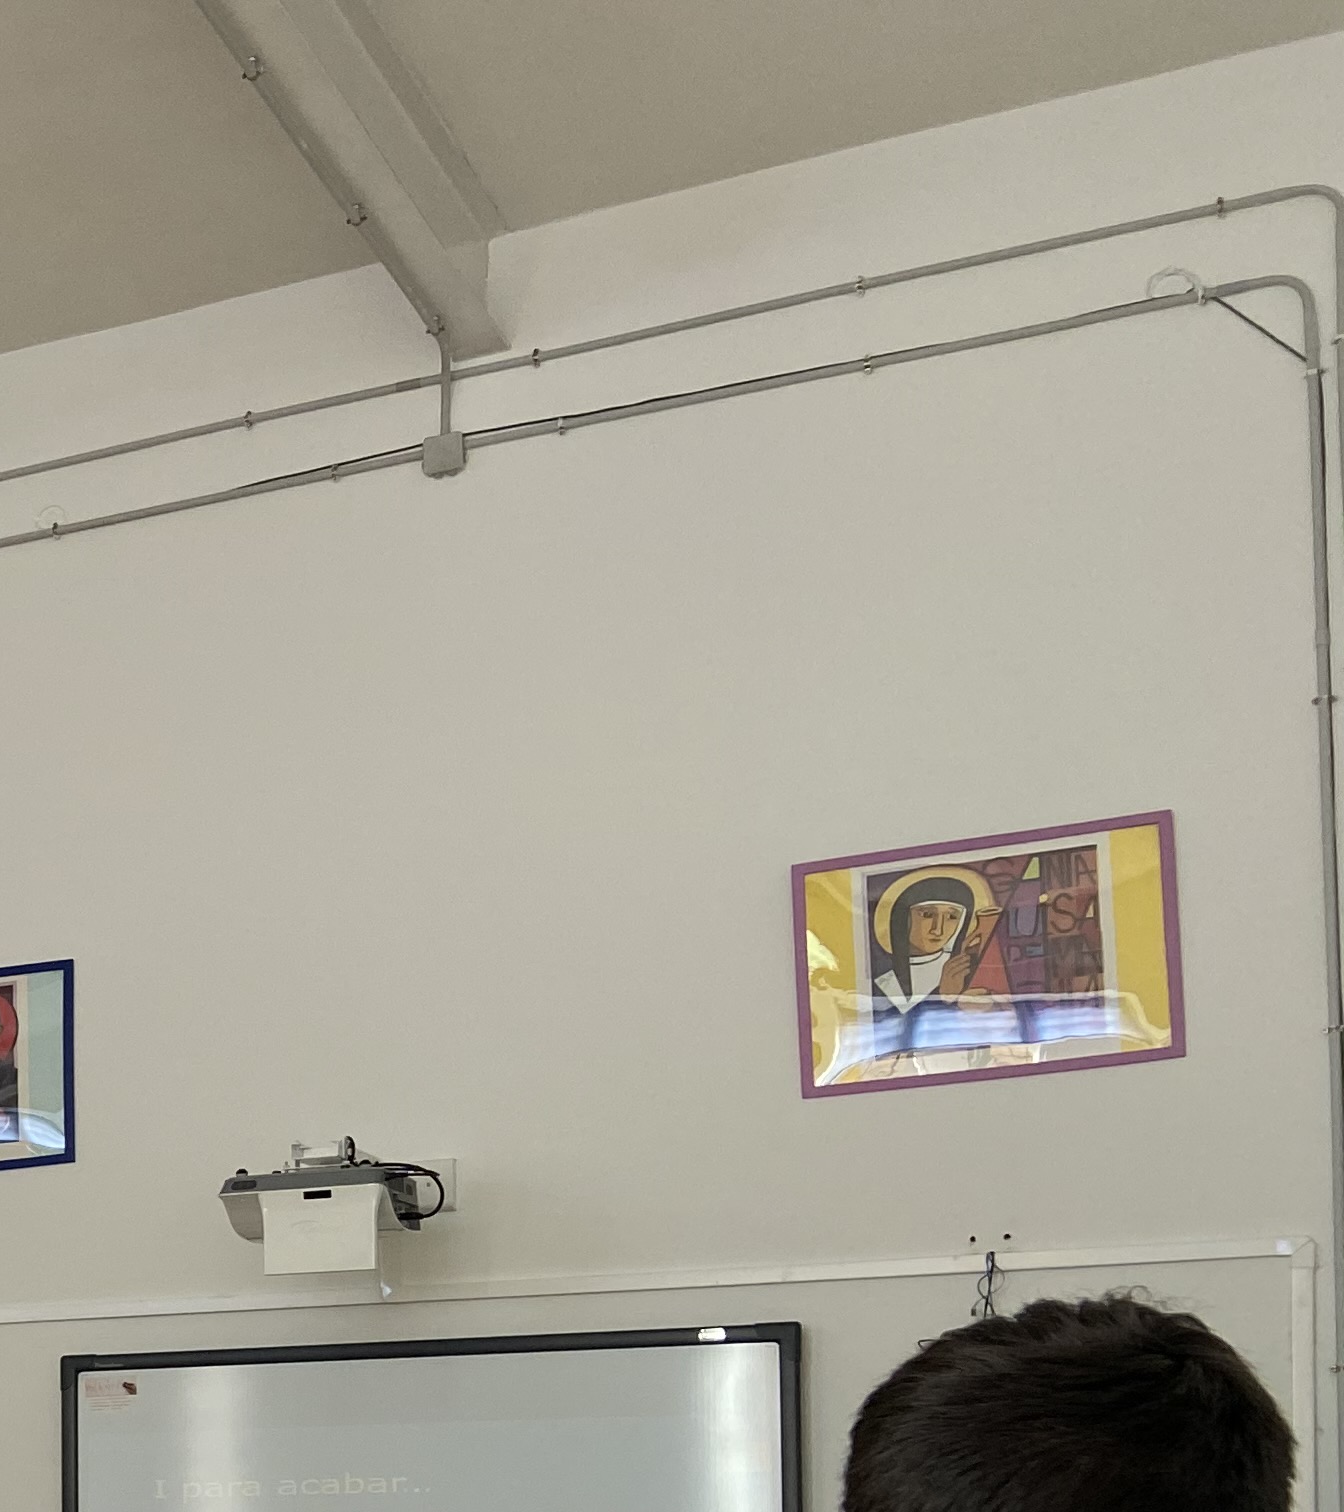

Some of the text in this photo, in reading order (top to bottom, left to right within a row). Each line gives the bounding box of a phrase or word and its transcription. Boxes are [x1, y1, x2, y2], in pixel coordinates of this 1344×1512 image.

[154, 1472, 431, 1504] I para acabar...
